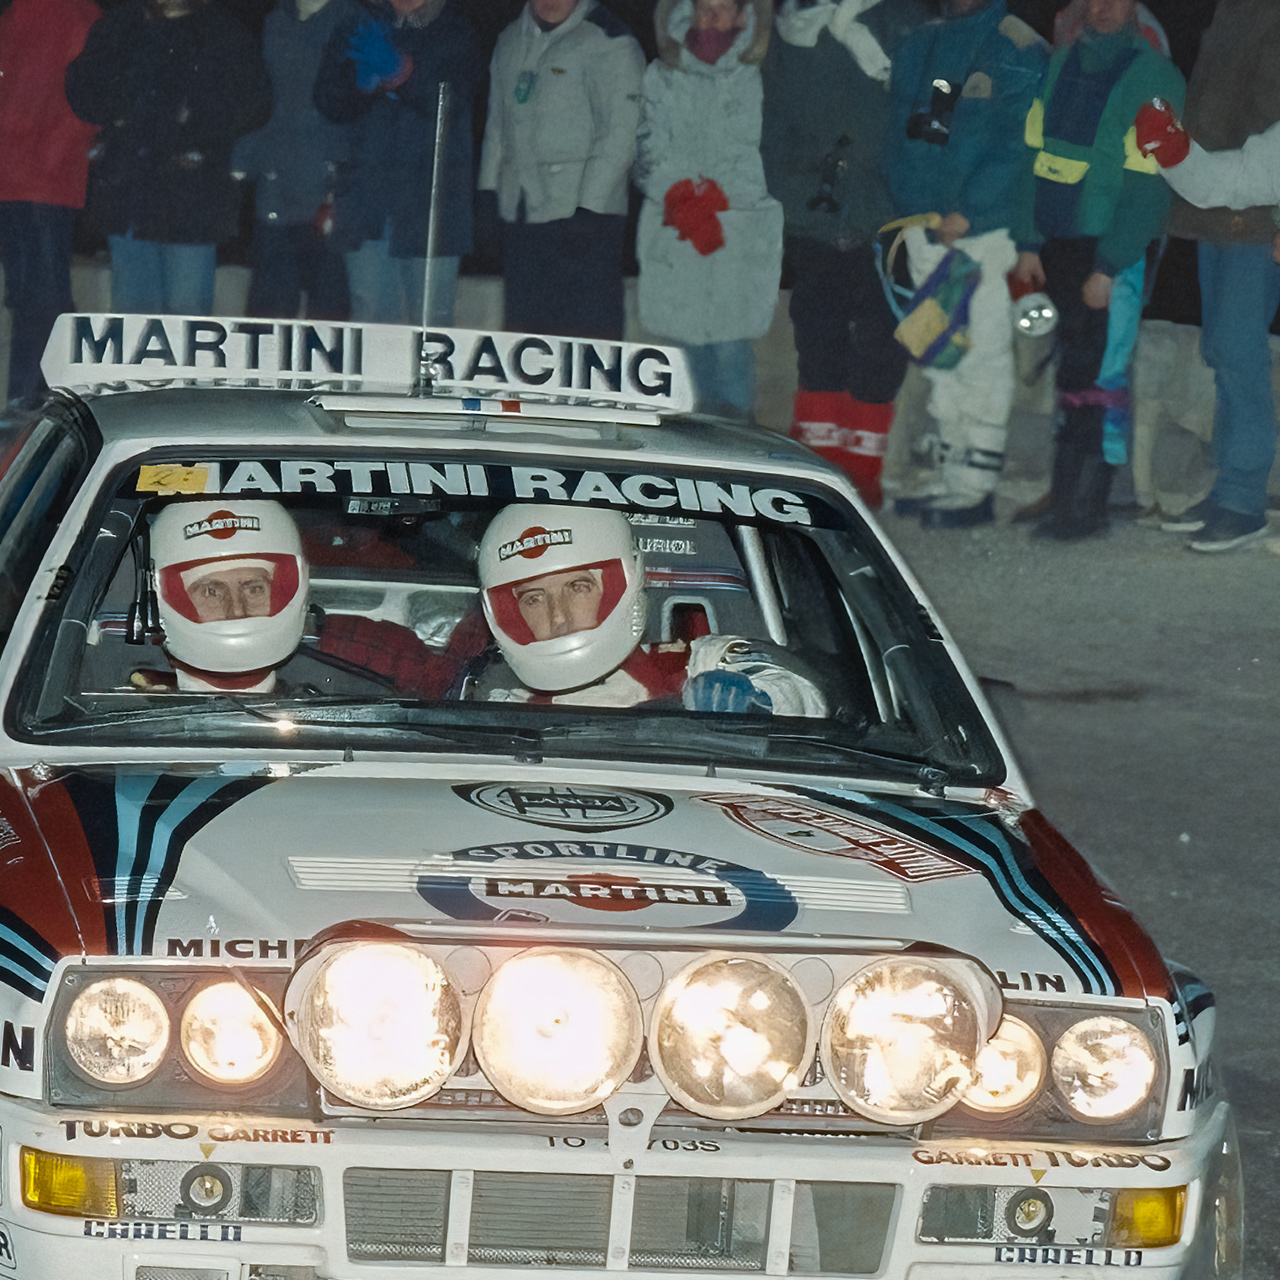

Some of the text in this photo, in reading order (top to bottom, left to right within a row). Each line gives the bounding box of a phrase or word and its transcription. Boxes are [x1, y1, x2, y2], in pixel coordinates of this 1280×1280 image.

[70, 316, 672, 397] MARTINI RACING
[512, 467, 811, 525] RACING
[184, 516, 260, 538] MARTINI
[499, 530, 572, 559] MARTINI
[468, 842, 726, 874] SPORTLINE
[497, 881, 718, 904] MARTINI
[59, 1120, 336, 1144] TURBO GARRETT
[912, 1149, 1172, 1172] GARRETT TURBO
